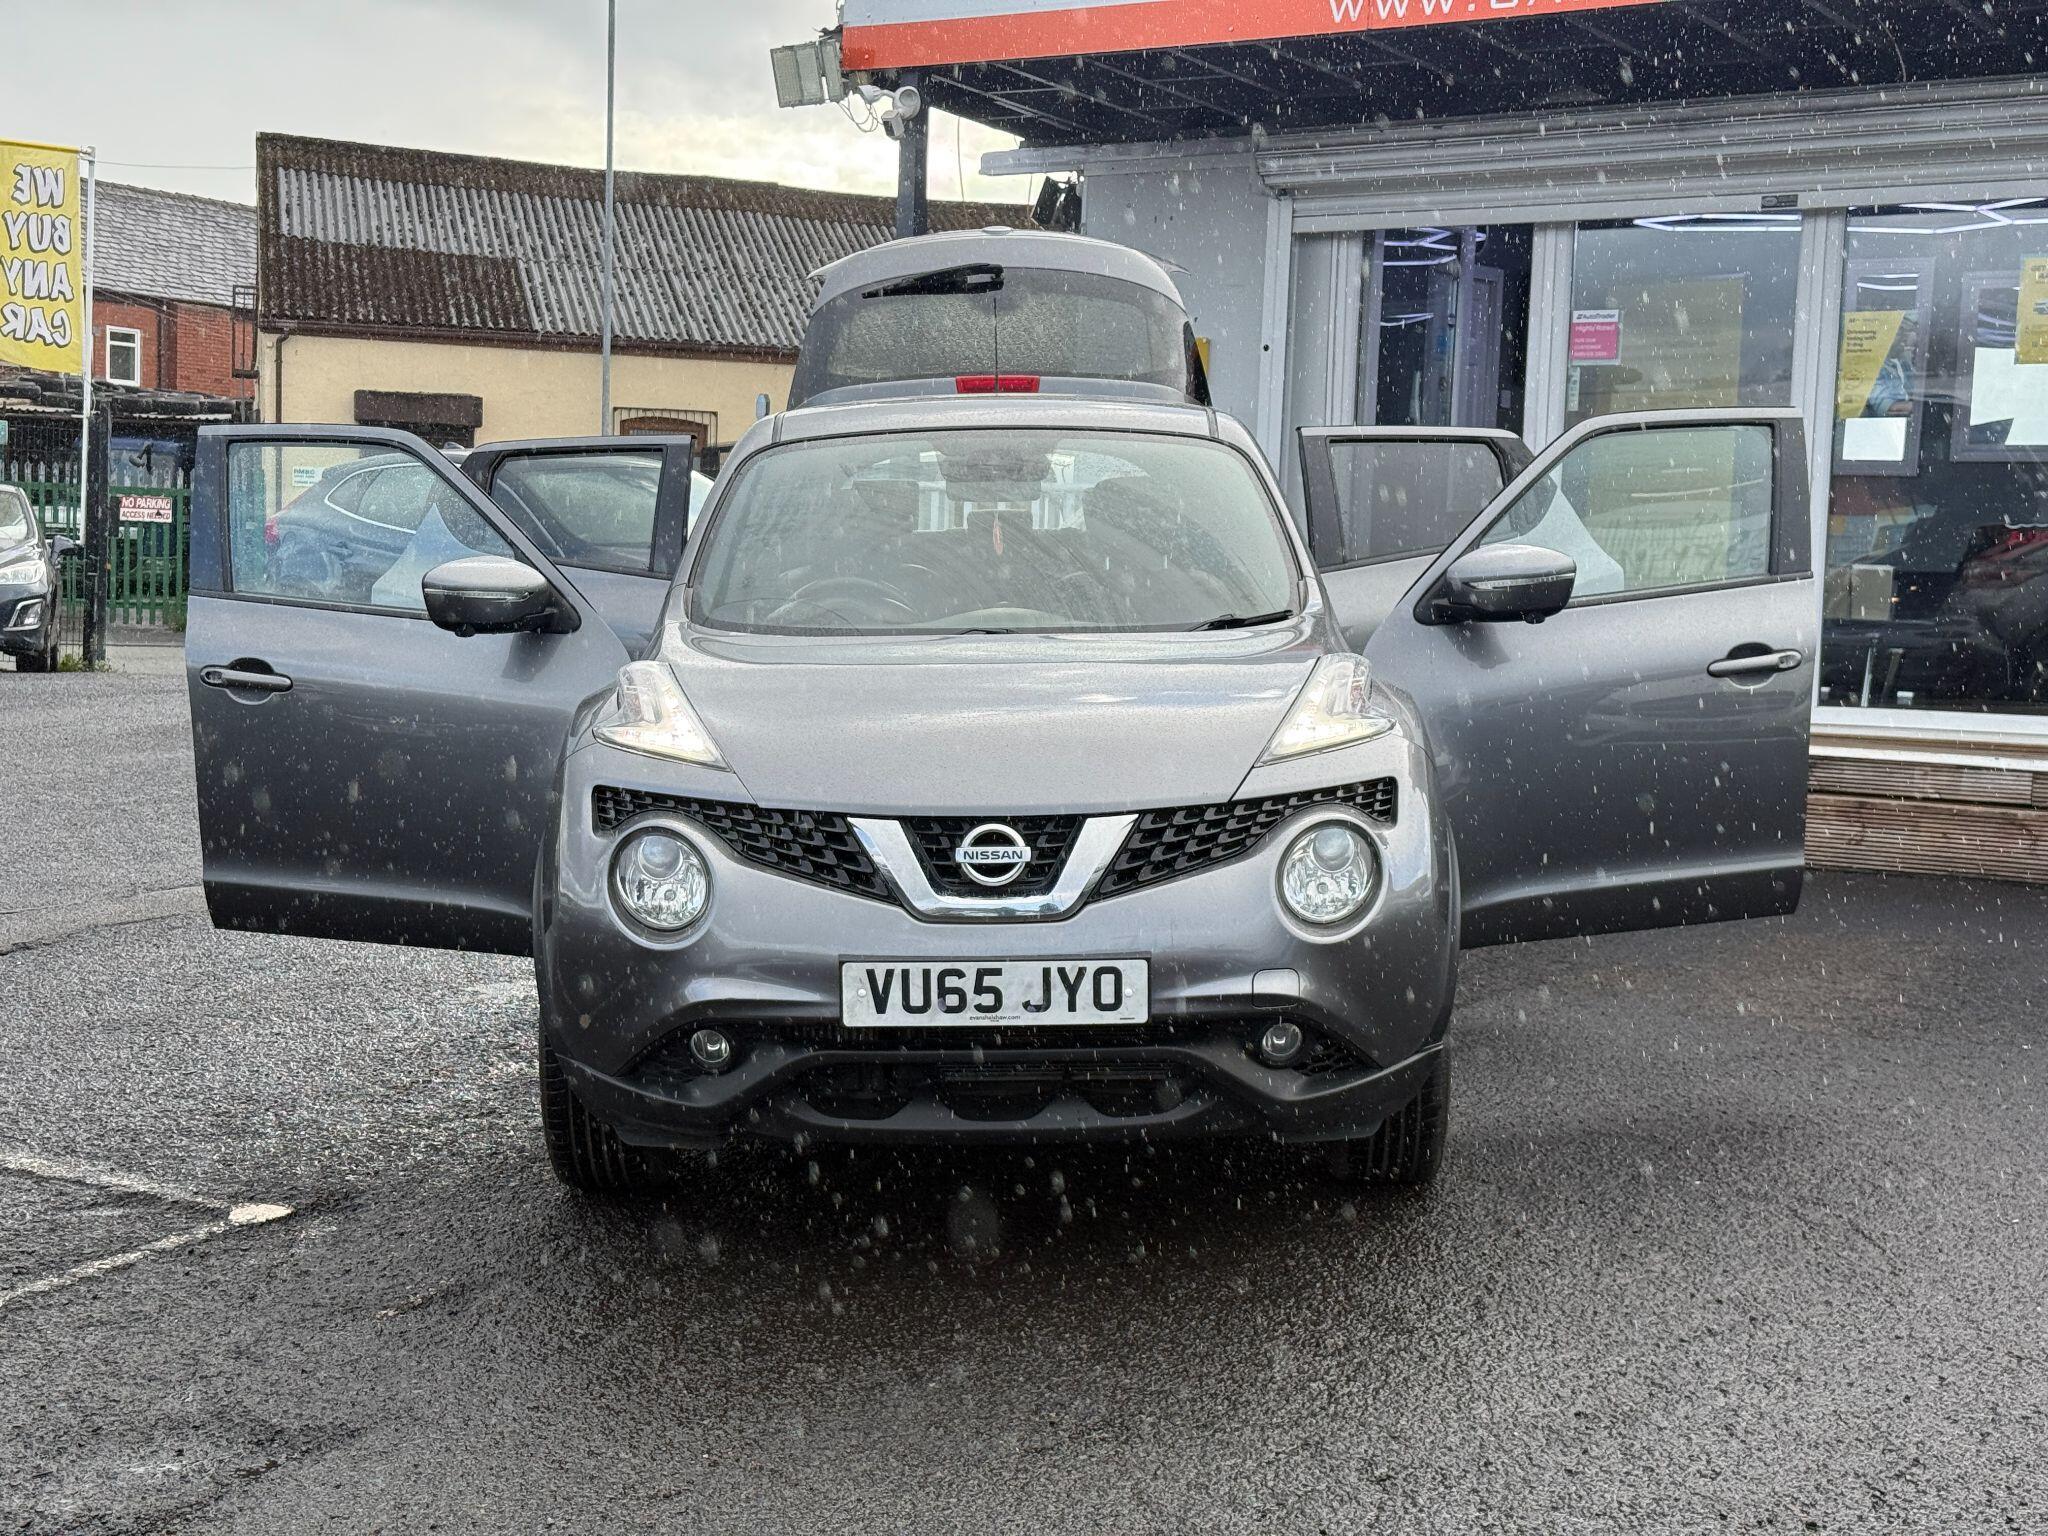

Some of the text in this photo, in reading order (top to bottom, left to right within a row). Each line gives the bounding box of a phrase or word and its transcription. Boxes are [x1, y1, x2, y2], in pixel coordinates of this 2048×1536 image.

[121, 496, 170, 509] NO PARKING
[122, 510, 145, 519] ACCESS
[964, 850, 1023, 860] NISSAN
[866, 966, 1123, 1014] VU65 JYO
